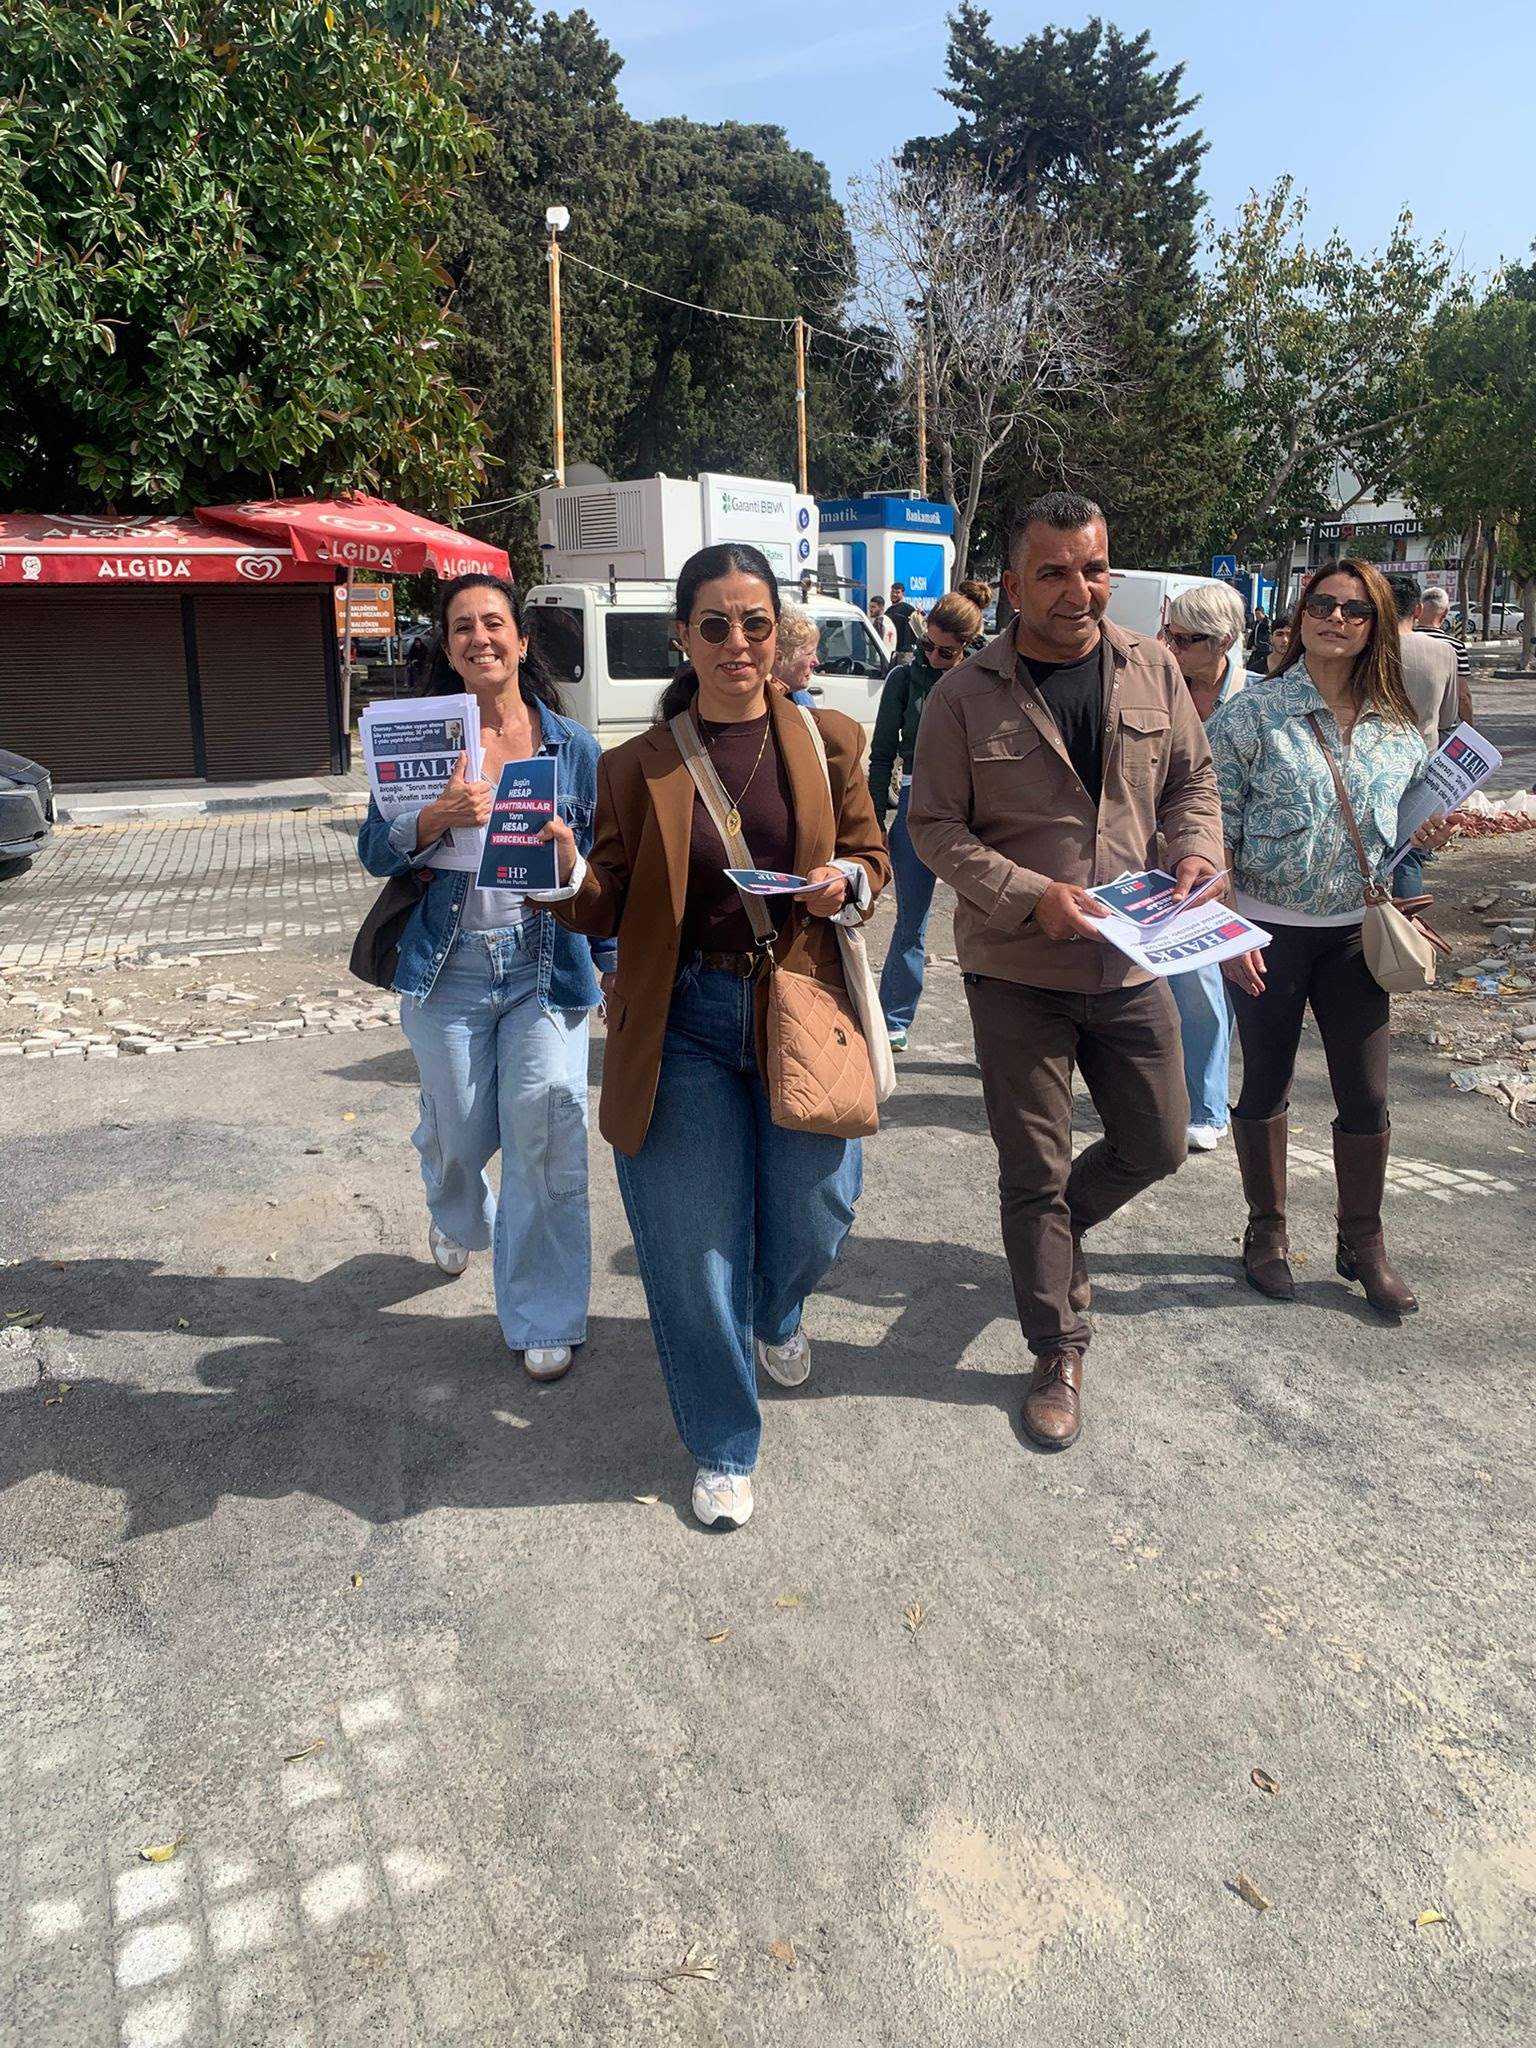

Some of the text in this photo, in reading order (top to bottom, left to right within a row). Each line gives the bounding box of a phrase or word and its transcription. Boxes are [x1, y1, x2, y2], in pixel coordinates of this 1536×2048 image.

[732, 497, 785, 514] Garanti BBVA
[820, 508, 858, 523] matik
[906, 508, 942, 525] Bankamatik
[766, 550, 784, 561] Rates
[910, 576, 927, 591] CASH
[398, 759, 459, 778] HALK
[512, 778, 530, 788] Bugün
[508, 788, 532, 798] HESAP
[494, 801, 551, 811] KAPATTIRANLAR
[508, 812, 524, 821] Yarın
[502, 822, 529, 832] HESAP
[508, 866, 528, 879] HP
[1150, 931, 1226, 964] HALK
